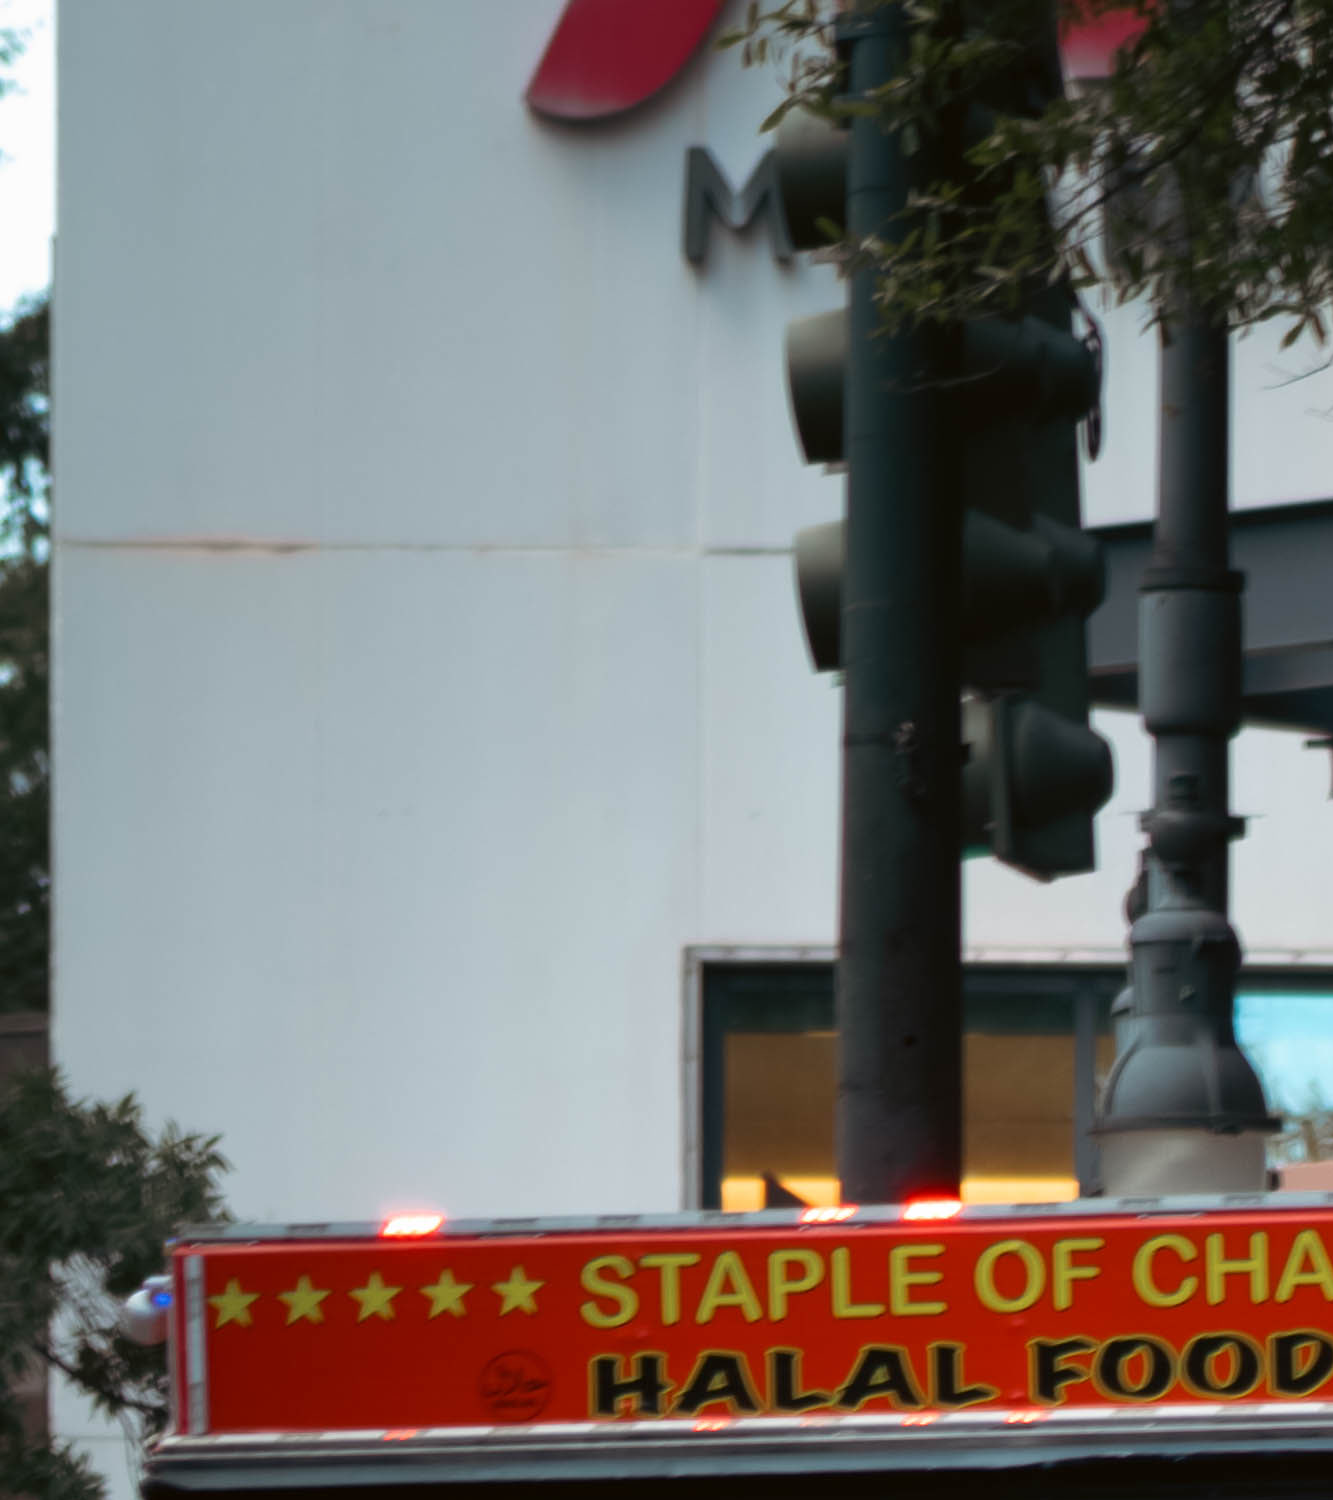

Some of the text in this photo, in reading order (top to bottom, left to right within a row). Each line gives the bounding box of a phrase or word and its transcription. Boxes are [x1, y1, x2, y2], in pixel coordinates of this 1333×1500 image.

[579, 1243, 948, 1329] STAPLE
[973, 1236, 1106, 1314] OF
[588, 1343, 995, 1419] HALAL
